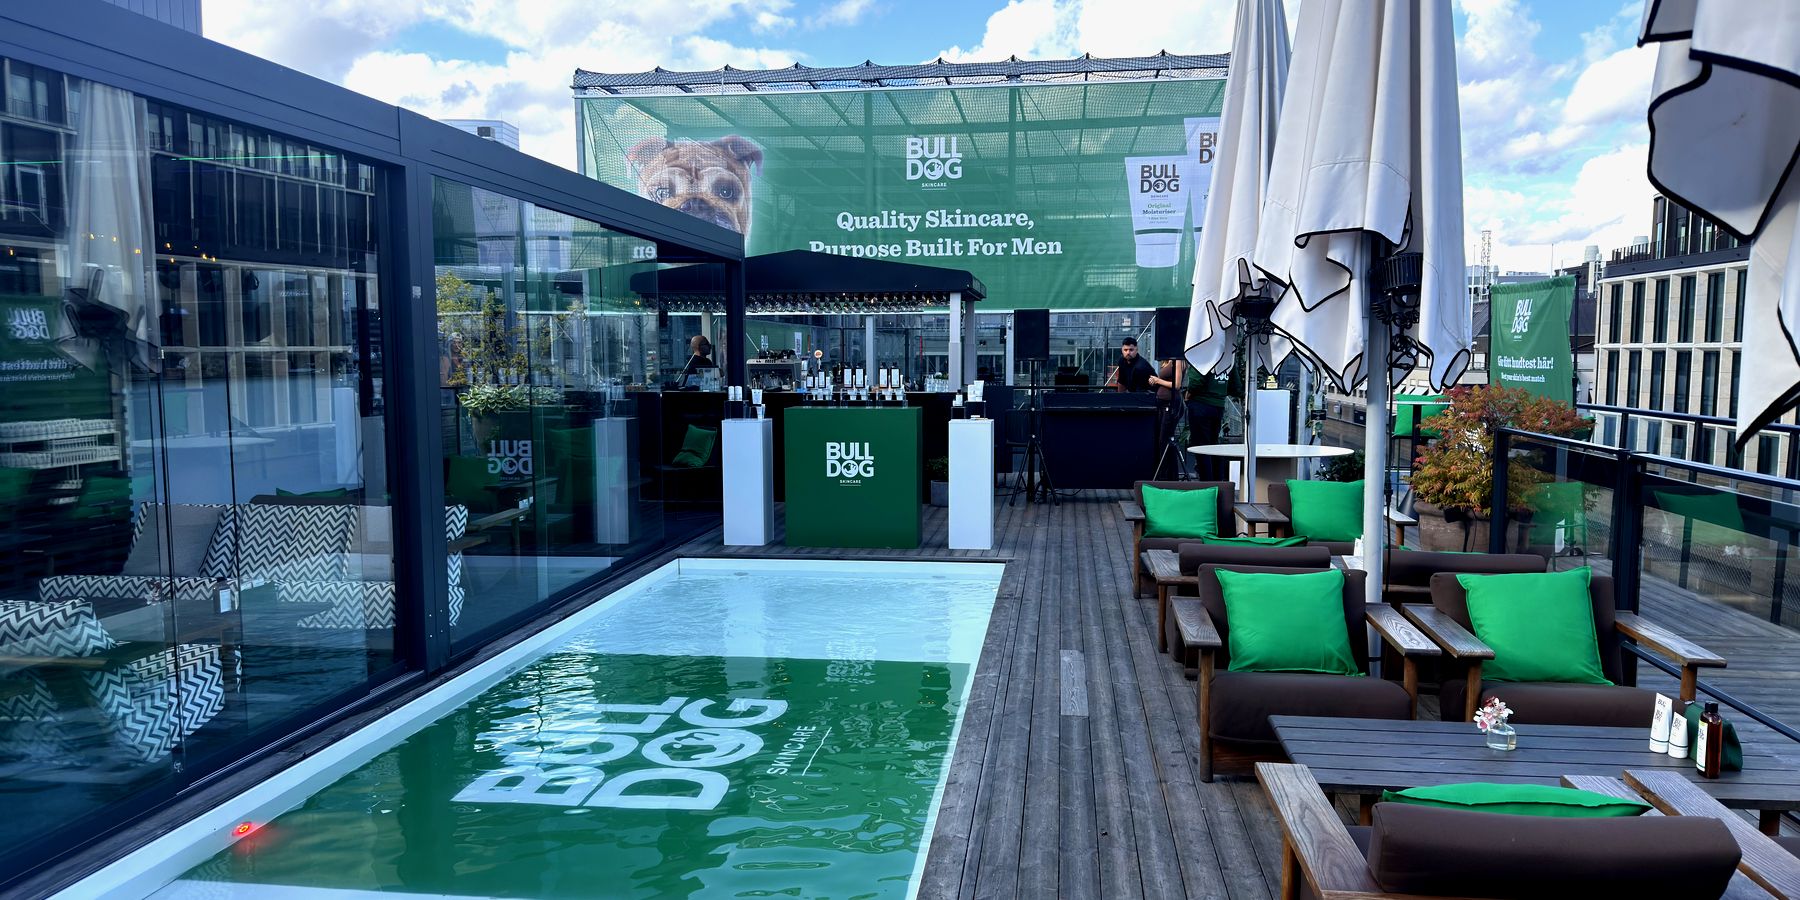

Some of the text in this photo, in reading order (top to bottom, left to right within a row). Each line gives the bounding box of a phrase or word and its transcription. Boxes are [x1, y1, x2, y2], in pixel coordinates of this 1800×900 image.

[906, 136, 963, 158] BULL
[906, 158, 963, 181] DOG
[1140, 164, 1180, 179] BULL
[1140, 179, 1180, 193] DOG
[836, 209, 1035, 231] Quality Skincare,
[809, 238, 1063, 258] Purpose Built For Men
[1515, 299, 1533, 317] BULL
[1511, 316, 1530, 333] DOG
[1537, 356, 1554, 369] här!
[826, 442, 875, 460] BULL
[826, 459, 875, 478] DOG
[450, 696, 689, 807] BULL
[583, 697, 789, 811] DOG
[767, 724, 818, 777] SKINCARE
